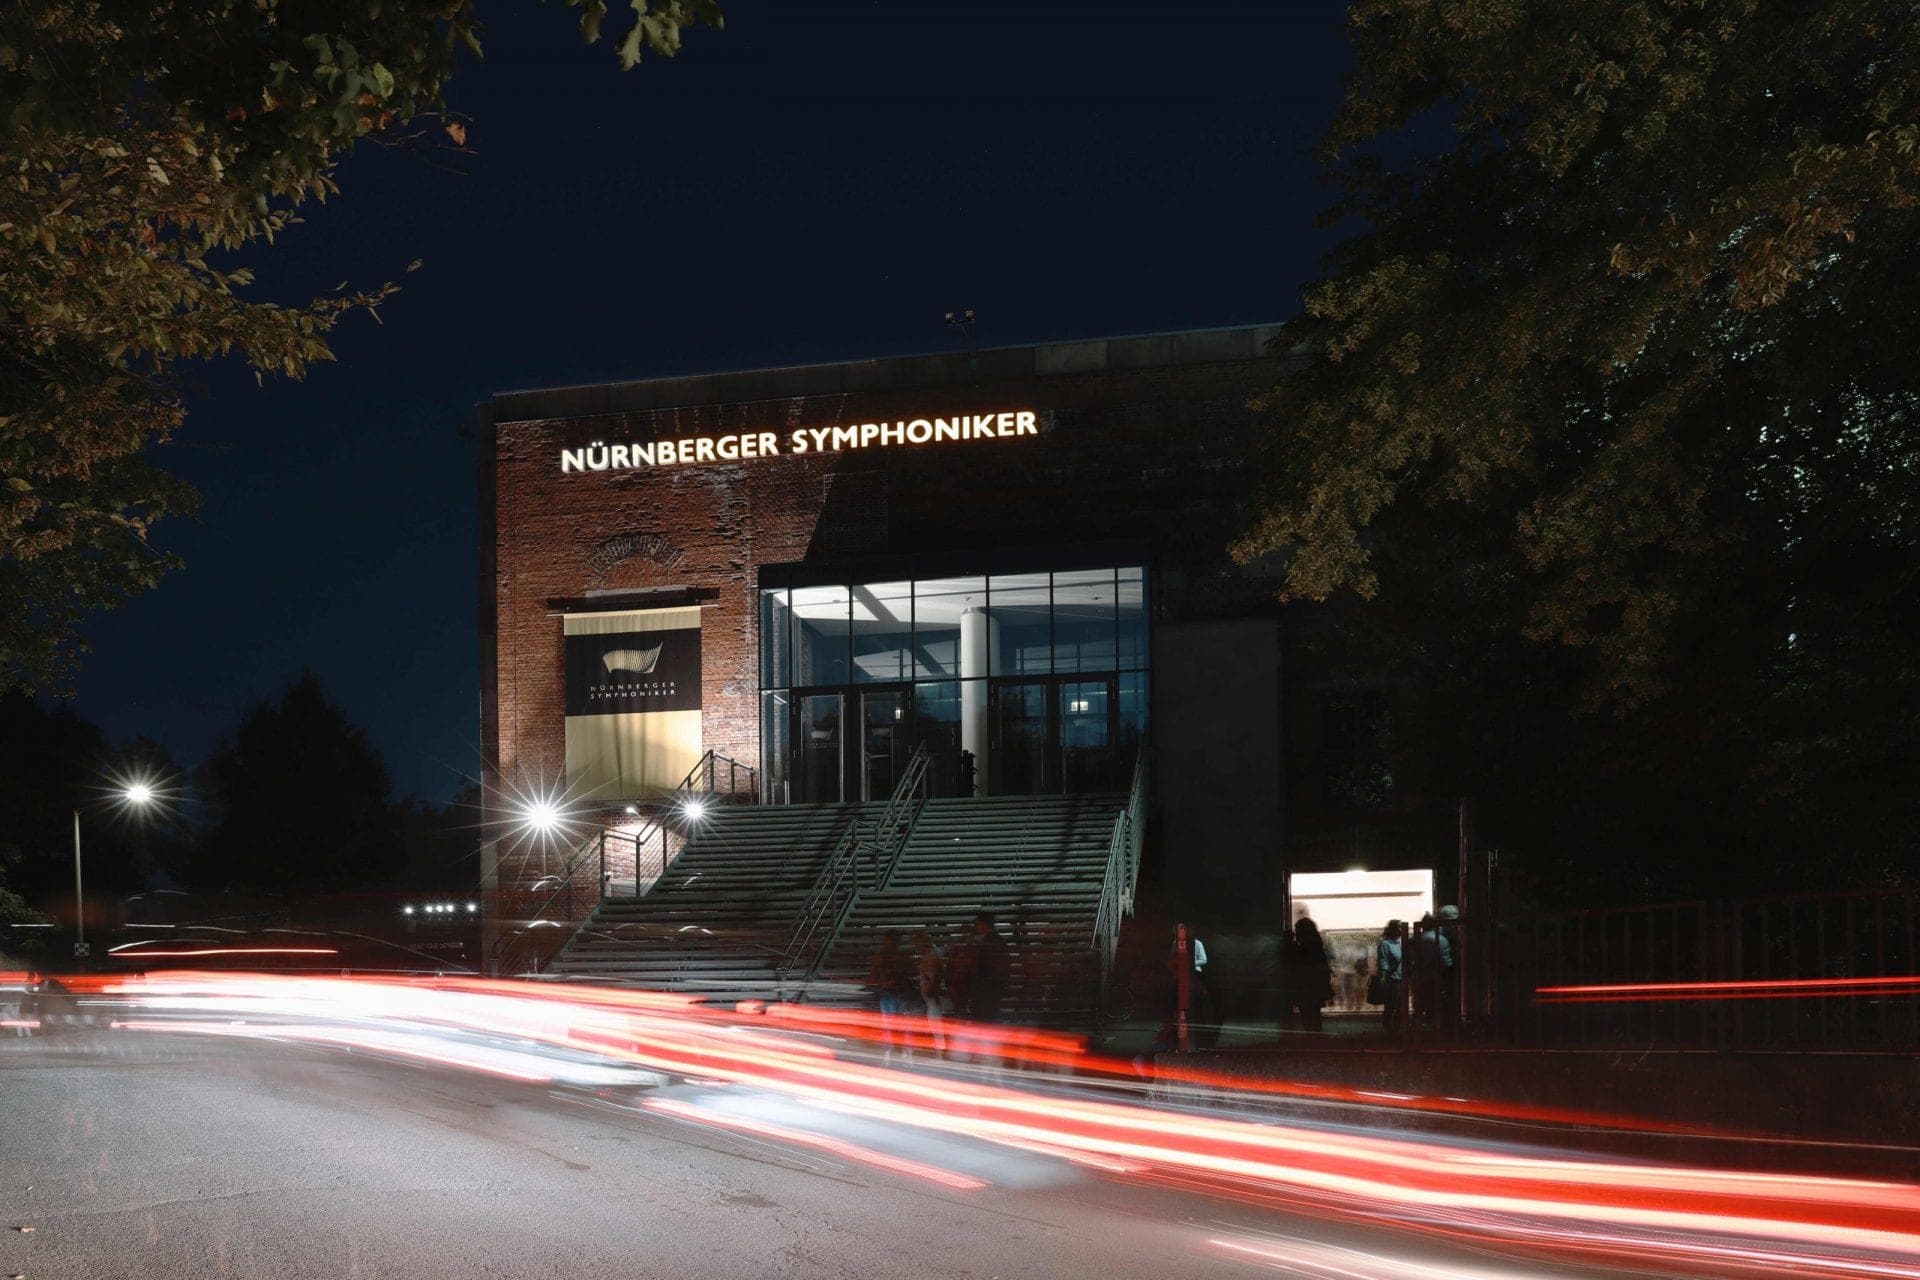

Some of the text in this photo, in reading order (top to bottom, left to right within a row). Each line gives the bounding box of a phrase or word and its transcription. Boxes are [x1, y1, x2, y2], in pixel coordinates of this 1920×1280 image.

[560, 410, 1038, 474] NÜRNBERGER SYMPHONIKER
[590, 689, 676, 700] SYMPHONIKER
